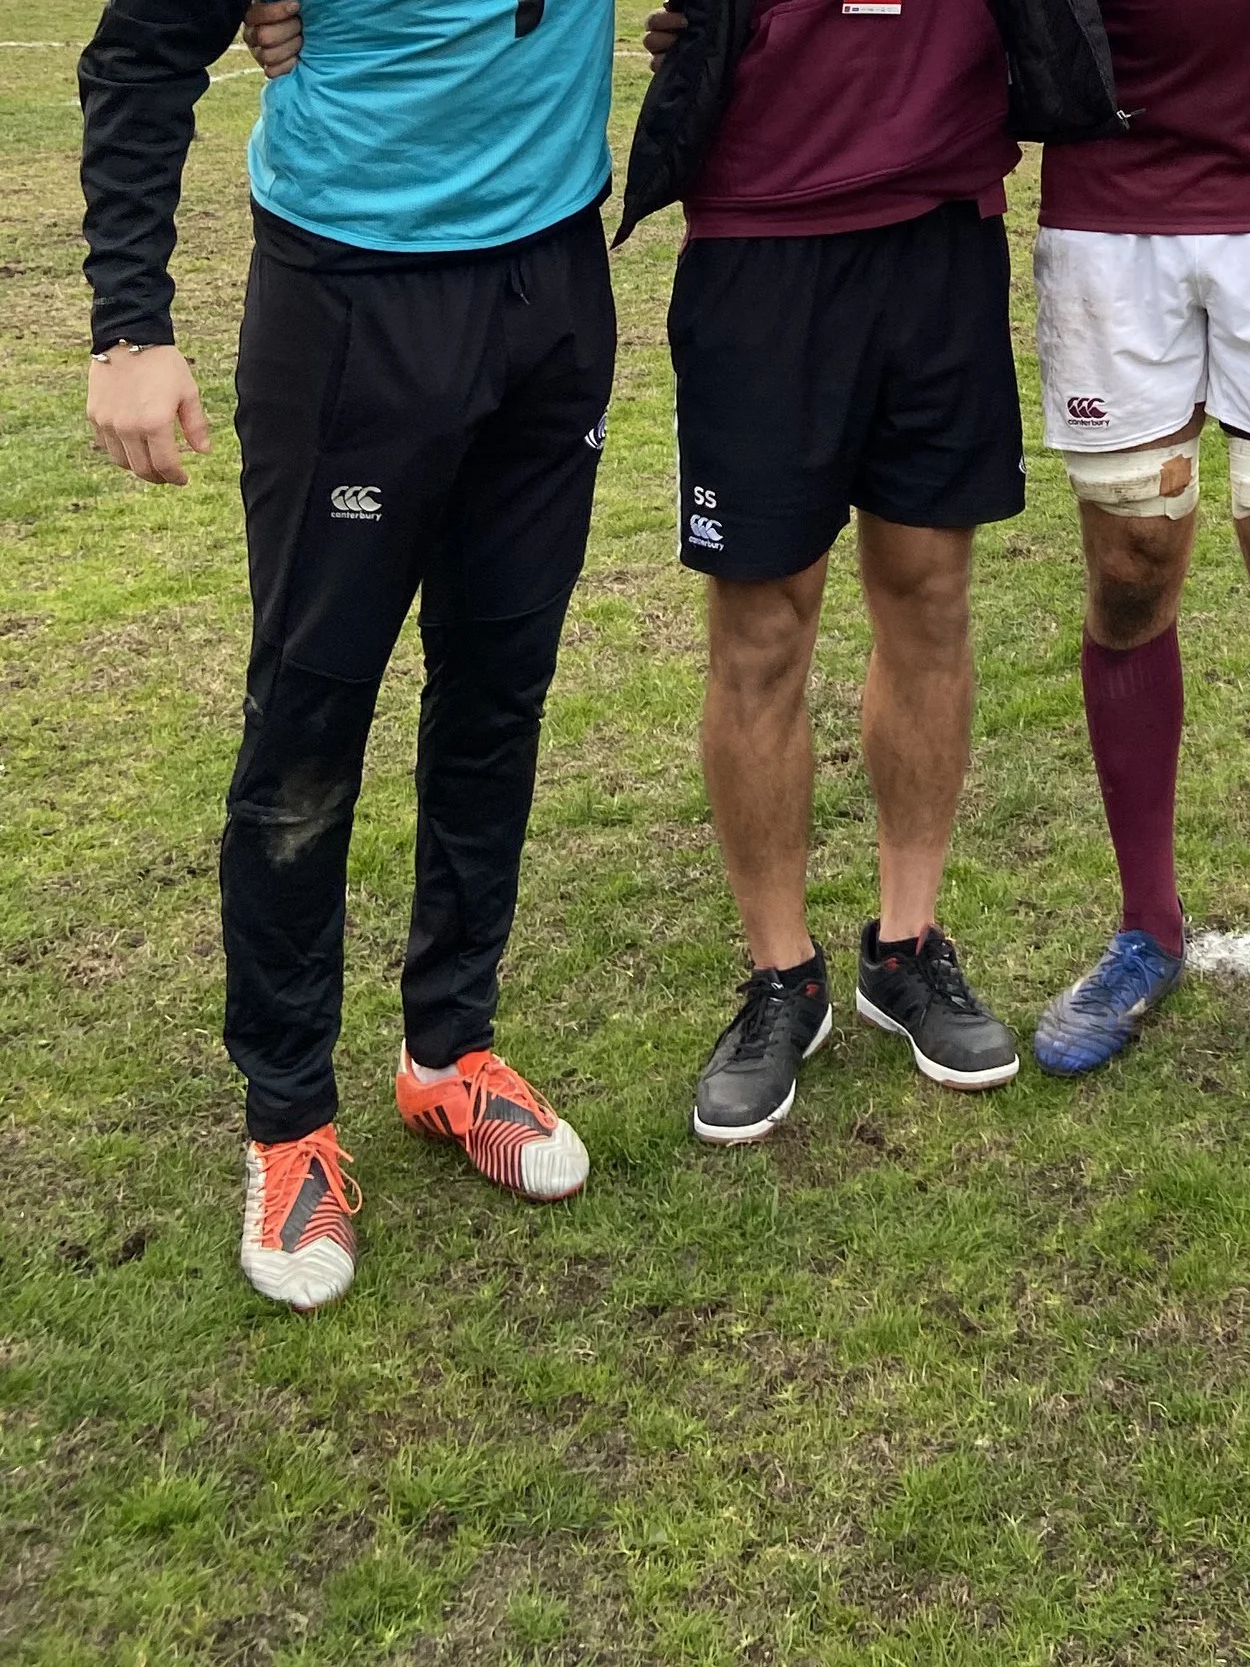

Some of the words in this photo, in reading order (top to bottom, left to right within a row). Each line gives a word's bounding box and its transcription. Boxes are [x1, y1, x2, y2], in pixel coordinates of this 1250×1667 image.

[1067, 419, 1110, 427] canterbury
[694, 486, 717, 509] SS
[330, 511, 382, 522] canterbury
